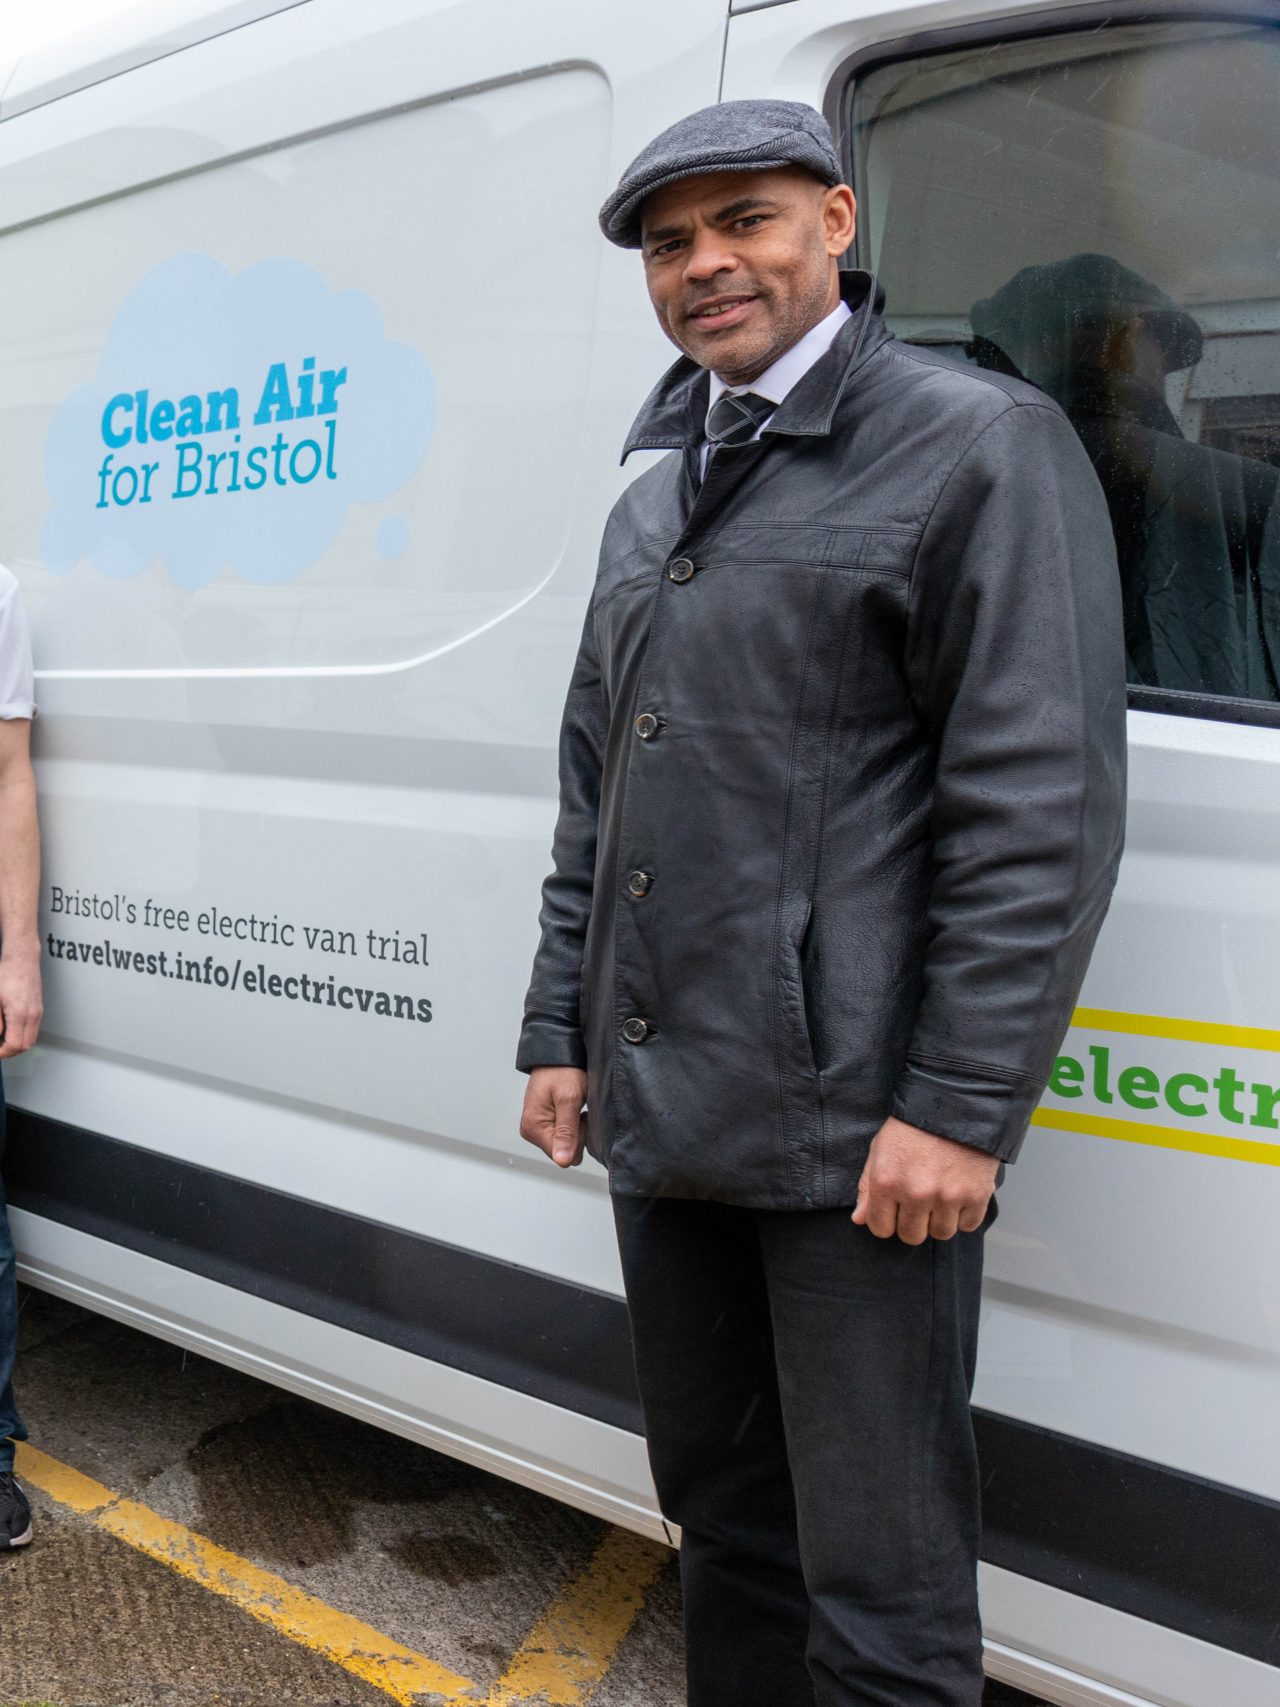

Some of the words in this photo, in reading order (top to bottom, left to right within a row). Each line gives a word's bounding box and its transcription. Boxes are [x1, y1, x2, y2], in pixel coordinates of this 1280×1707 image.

[101, 389, 240, 449] Clean
[253, 357, 347, 426] Air
[96, 454, 159, 508] for
[172, 419, 337, 499] Bristol
[50, 886, 137, 924] Bristol's
[144, 898, 189, 932] free
[197, 907, 295, 947] electric
[303, 925, 358, 956] van
[366, 929, 430, 966] trial
[47, 932, 434, 1024] travelwest.info/electricvans
